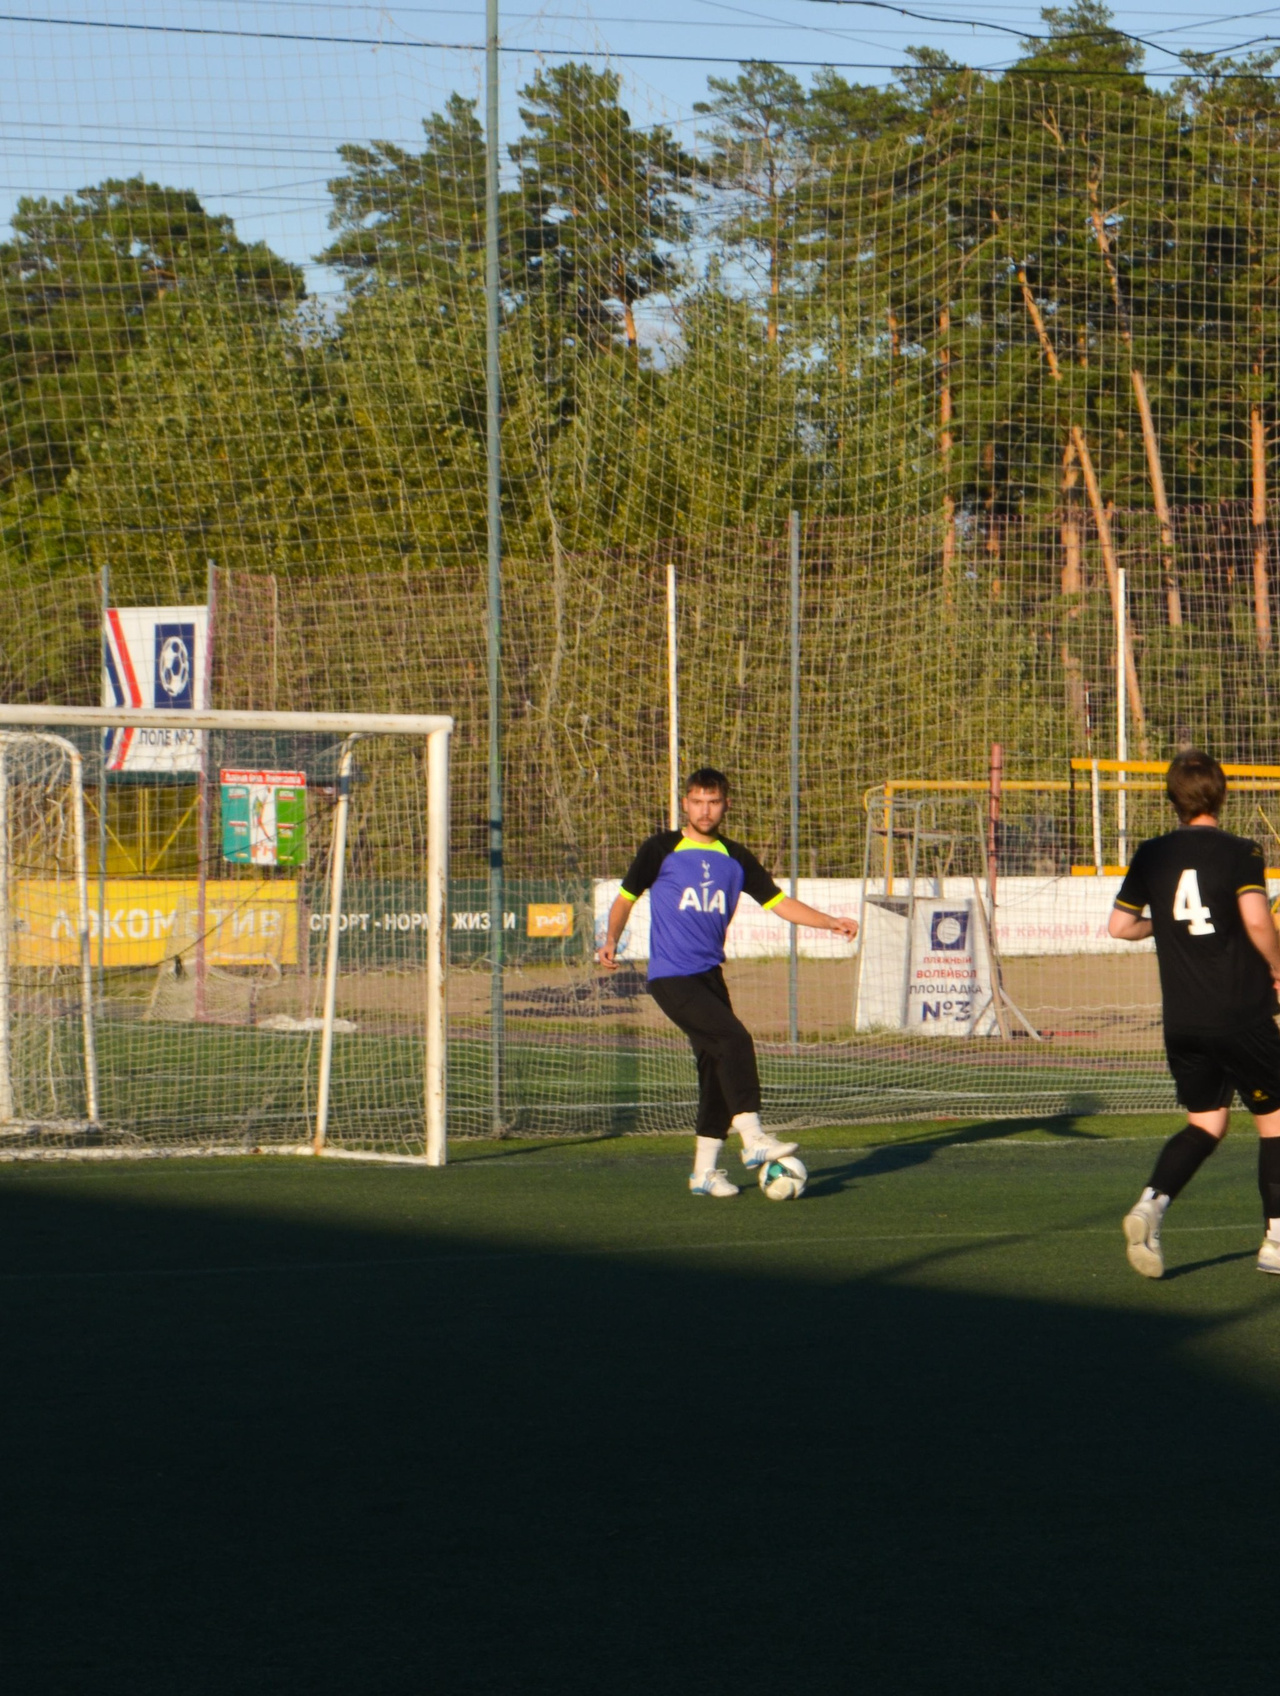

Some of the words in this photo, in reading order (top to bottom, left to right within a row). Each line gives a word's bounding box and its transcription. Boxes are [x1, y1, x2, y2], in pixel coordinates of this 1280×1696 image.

[140, 728, 172, 746] ПОЛЕ
[678, 887, 726, 915] AIA
[1172, 868, 1216, 936] 4
[384, 912, 429, 931] НОРМ
[451, 912, 516, 930] ЖИЗИ
[923, 955, 973, 965] ПЛЯЖНЫЙ
[916, 967, 978, 979] ВОЛЕЙБОЛ
[909, 983, 984, 996] ПЛОЩАДКА
